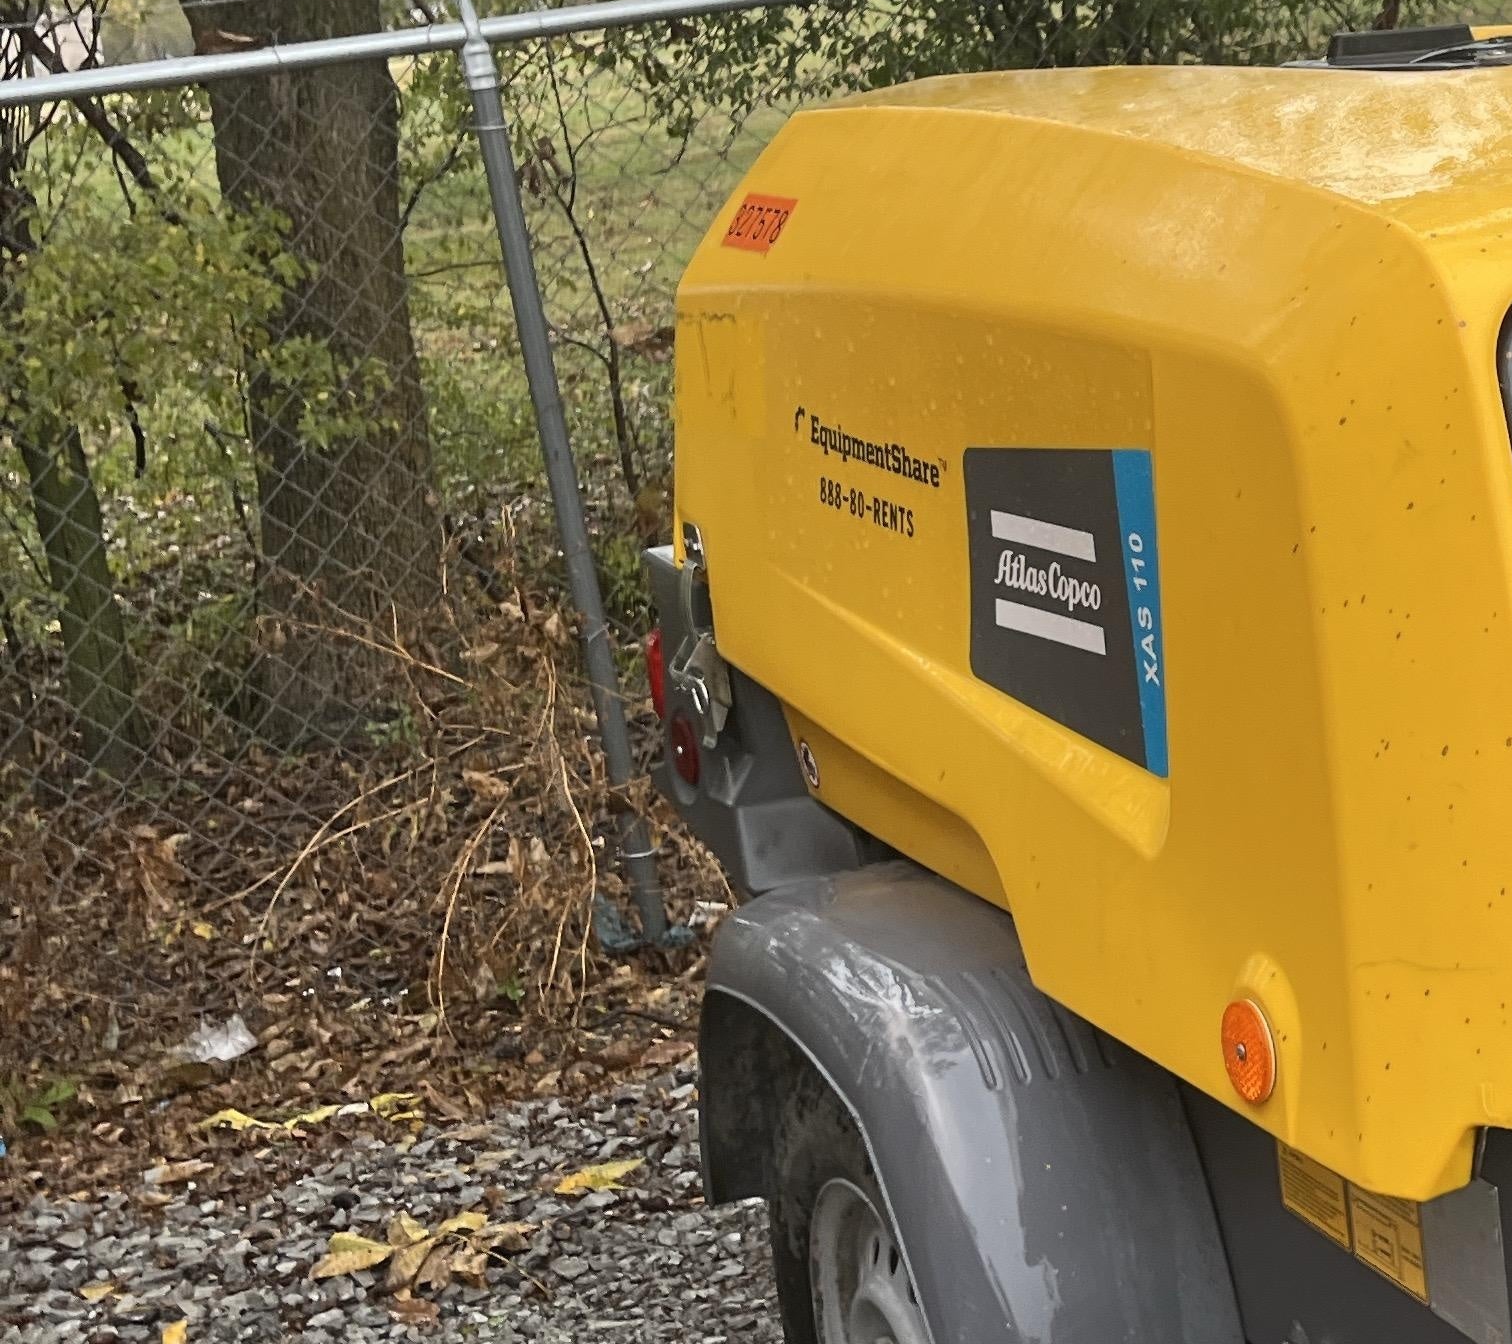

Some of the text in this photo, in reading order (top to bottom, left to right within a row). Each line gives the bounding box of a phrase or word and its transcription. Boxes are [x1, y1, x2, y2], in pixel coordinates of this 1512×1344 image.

[810, 414, 940, 488] EquipmentShare
[820, 476, 914, 538] 888-80-RENTS
[1128, 532, 1160, 687] XAS 110
